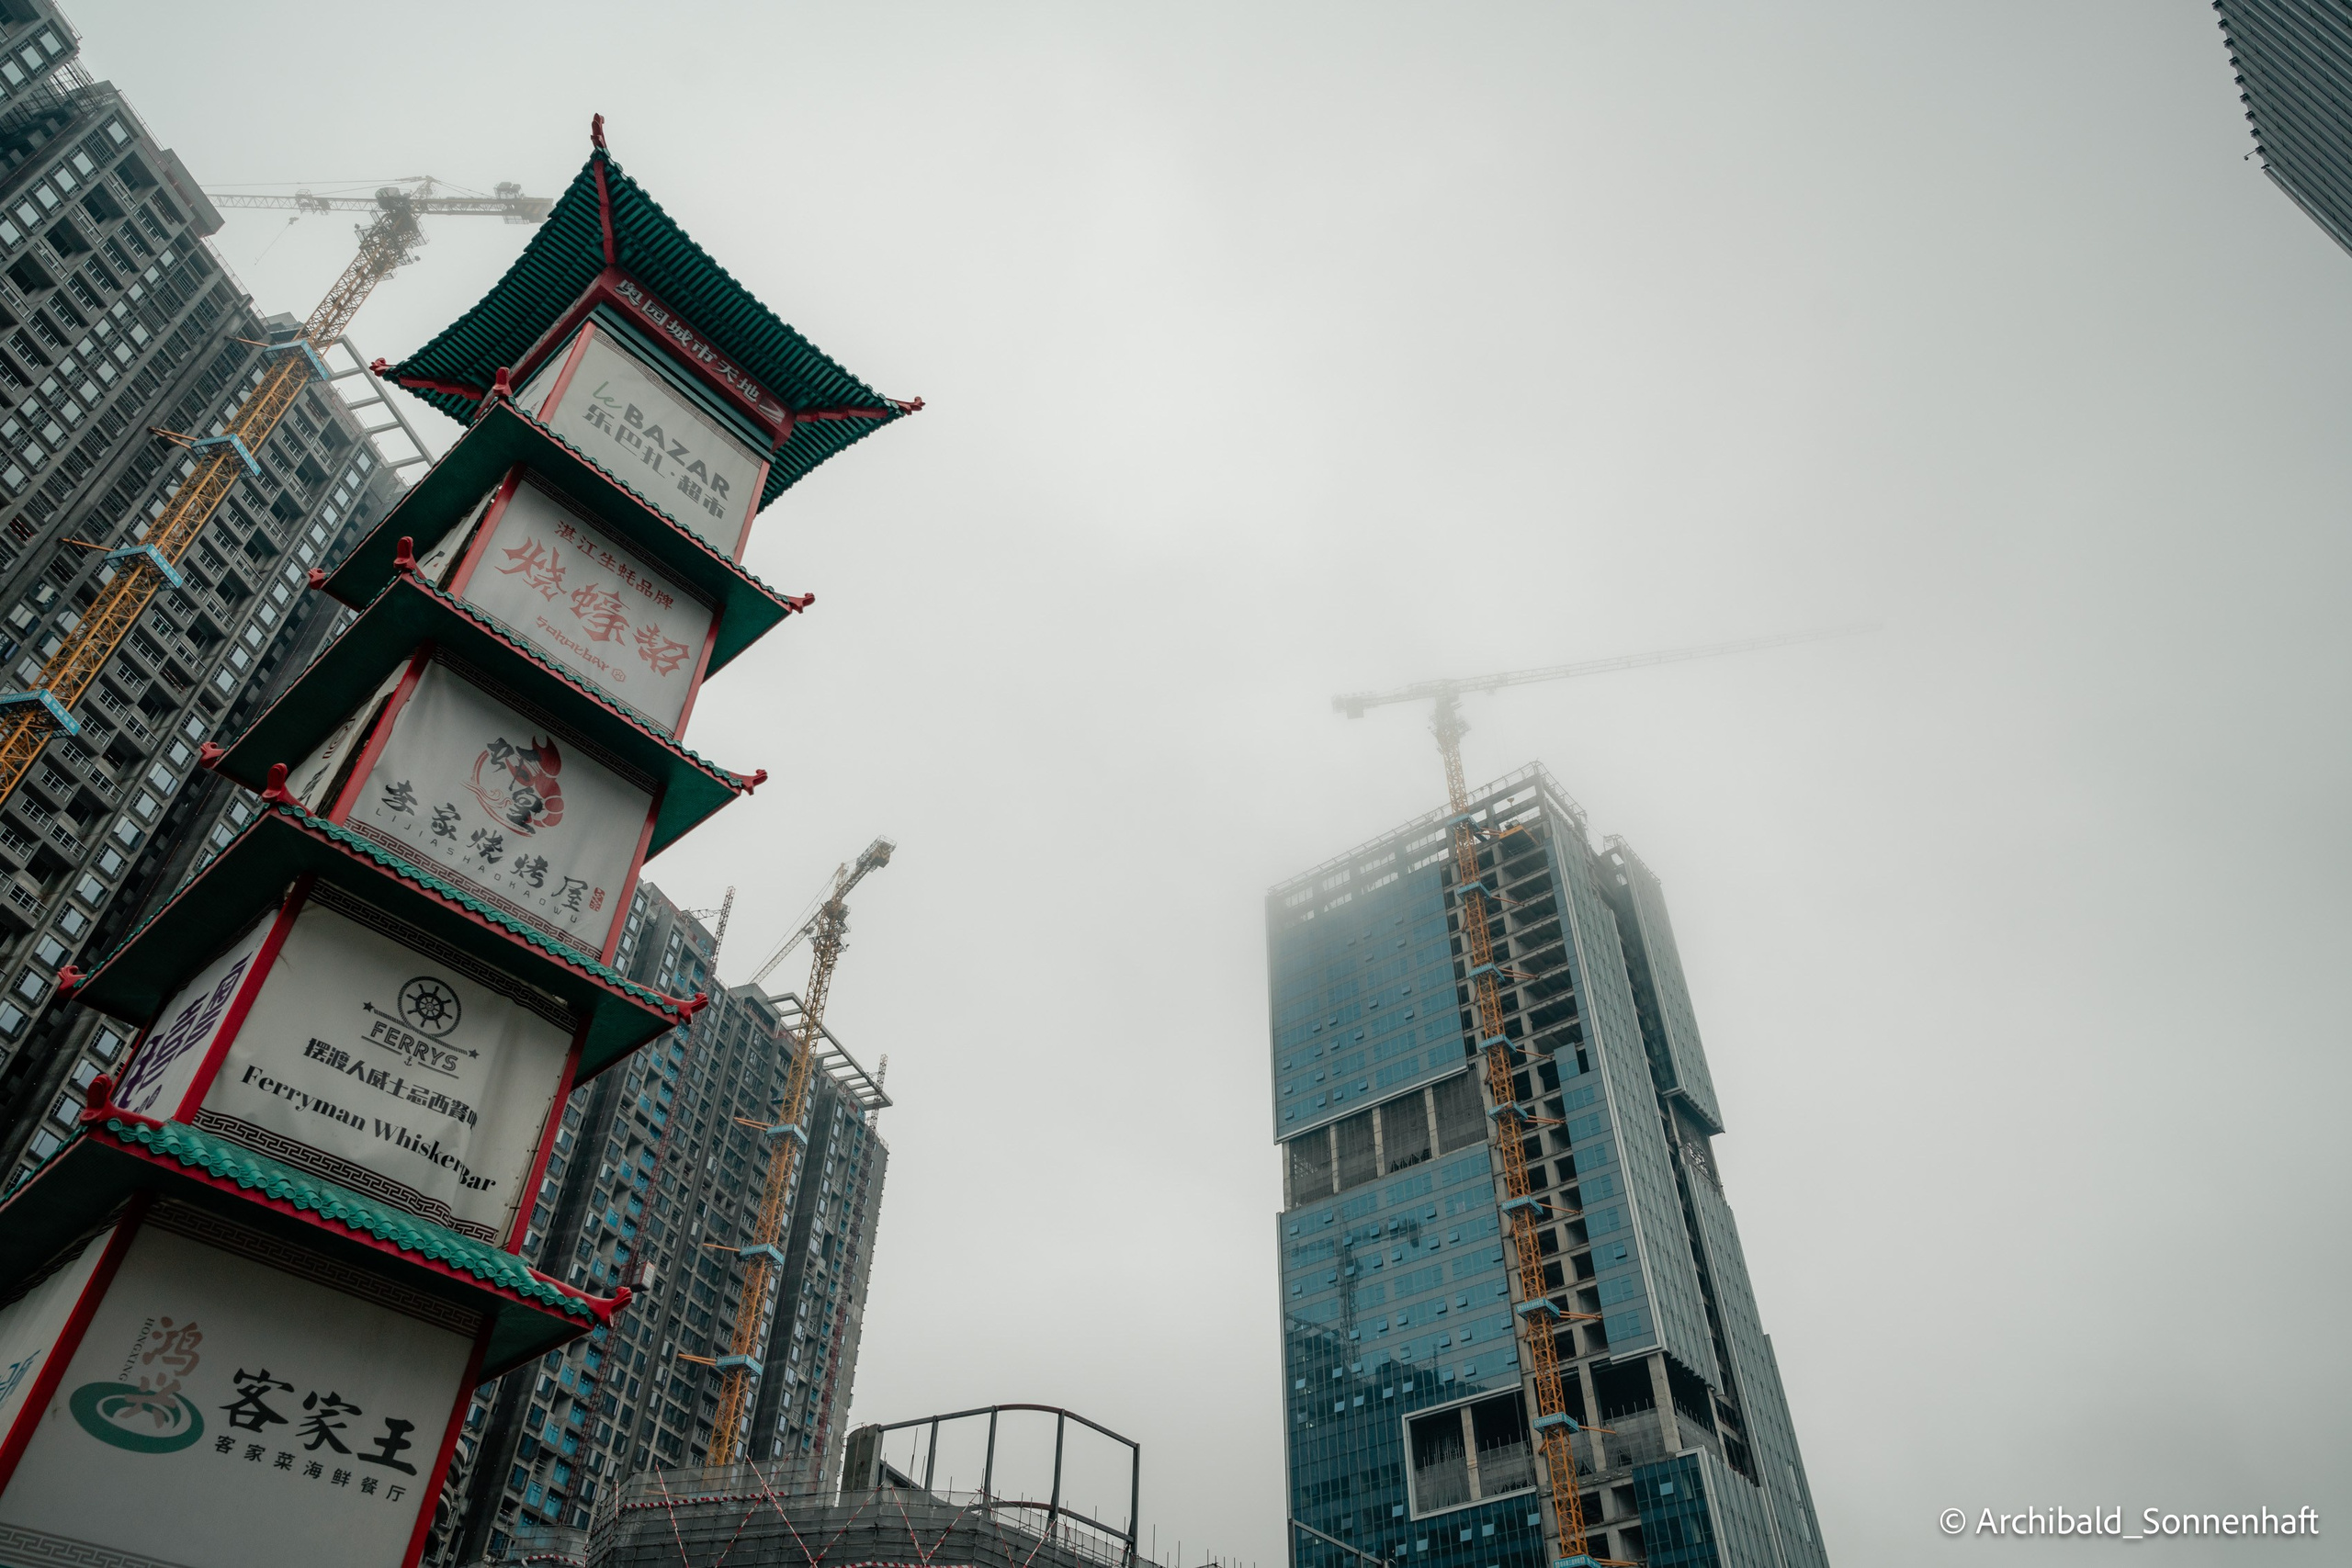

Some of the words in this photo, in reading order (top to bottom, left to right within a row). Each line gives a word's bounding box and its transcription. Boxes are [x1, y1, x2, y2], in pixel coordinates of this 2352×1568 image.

[613, 278, 760, 403] 奥园城市天地
[624, 403, 730, 501] BAZAR
[554, 520, 674, 611] 湛江生蚝品牌
[381, 780, 589, 912] 李家烧烤屋
[370, 1021, 458, 1071] FERRYS
[240, 1065, 366, 1132] Ferryman
[458, 1163, 497, 1192] Bar
[119, 1317, 155, 1382] HONGXING
[119, 1316, 203, 1429] 鸿兴
[214, 1434, 407, 1504] 客家菜海鲜餐厅
[219, 1368, 418, 1476] 客家王
